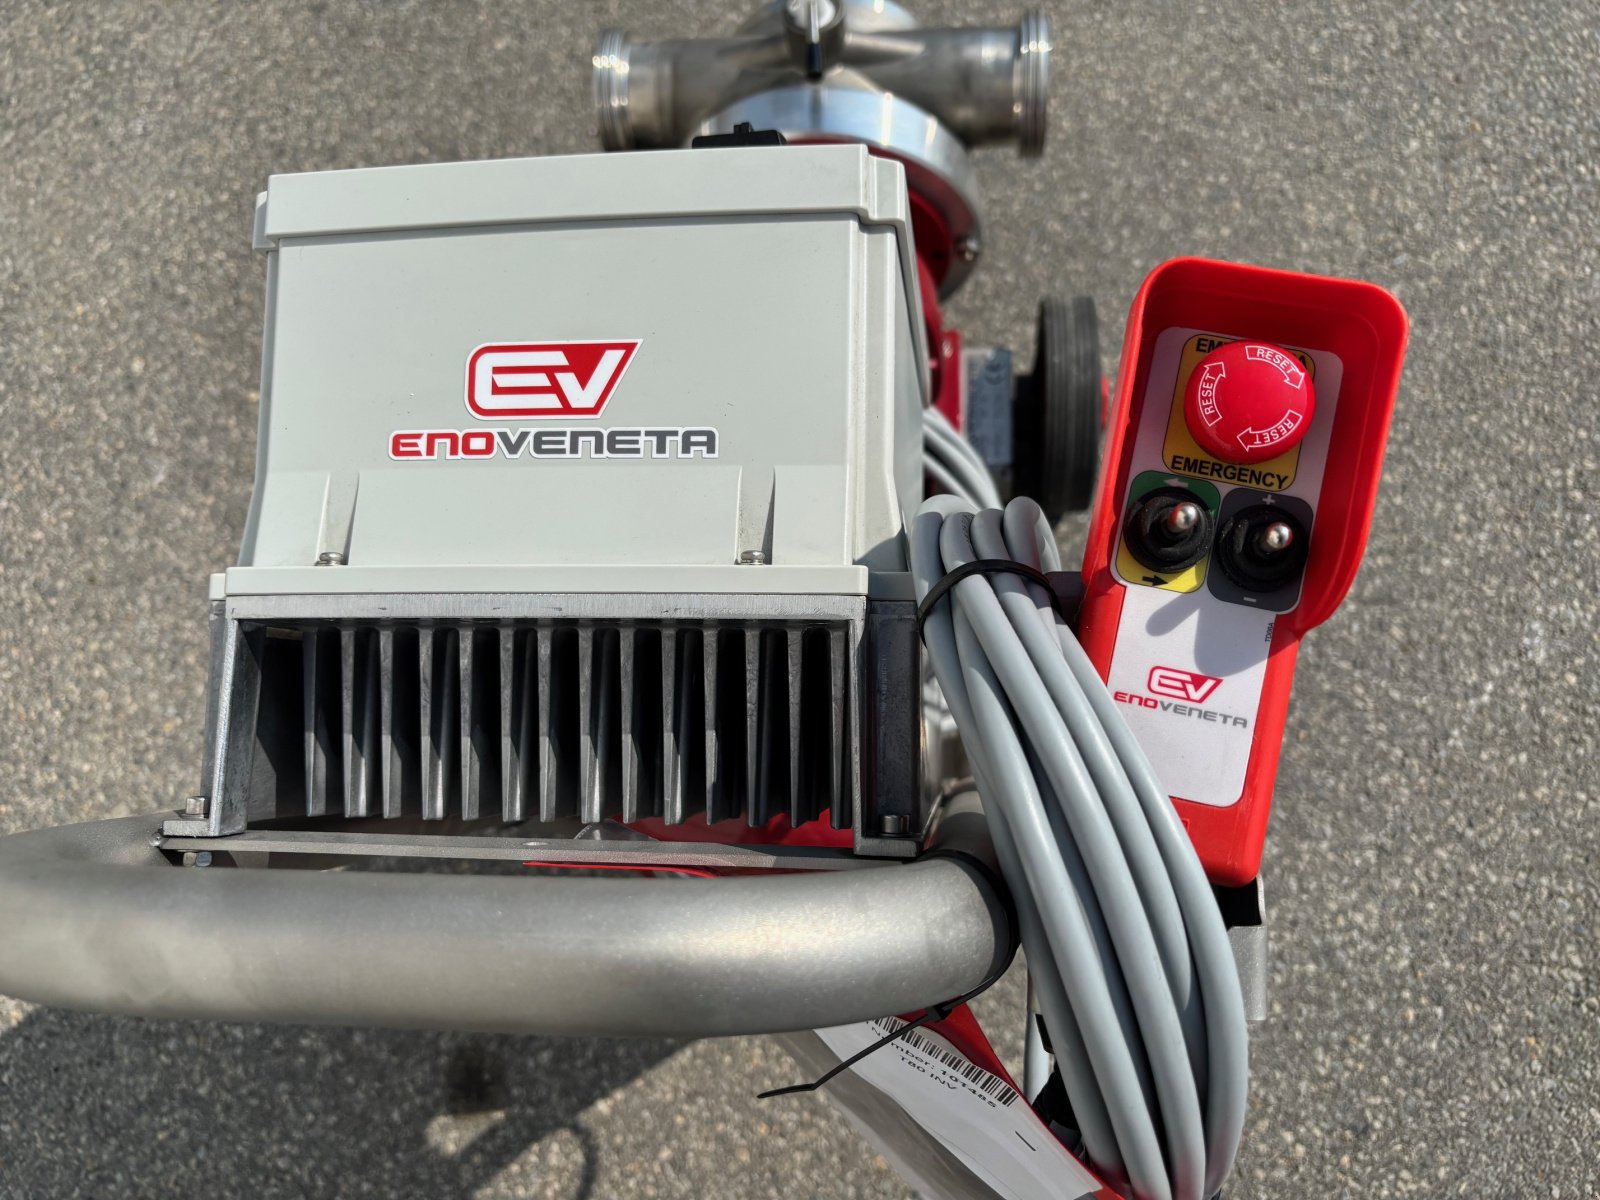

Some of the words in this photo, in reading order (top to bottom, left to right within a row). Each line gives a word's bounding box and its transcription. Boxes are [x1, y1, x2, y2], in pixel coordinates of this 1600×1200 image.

[1257, 348, 1297, 375] RESET
[470, 346, 632, 413] EV
[1201, 374, 1216, 415] RESET
[390, 429, 717, 457] ENOVENETA
[1253, 419, 1294, 445] RESET
[1170, 455, 1289, 490] EMERGENCY
[1149, 667, 1219, 702] EV
[1114, 691, 1248, 729] ENOVENETA
[871, 1026, 935, 1070] Nmber:
[929, 1073, 957, 1090] INV
